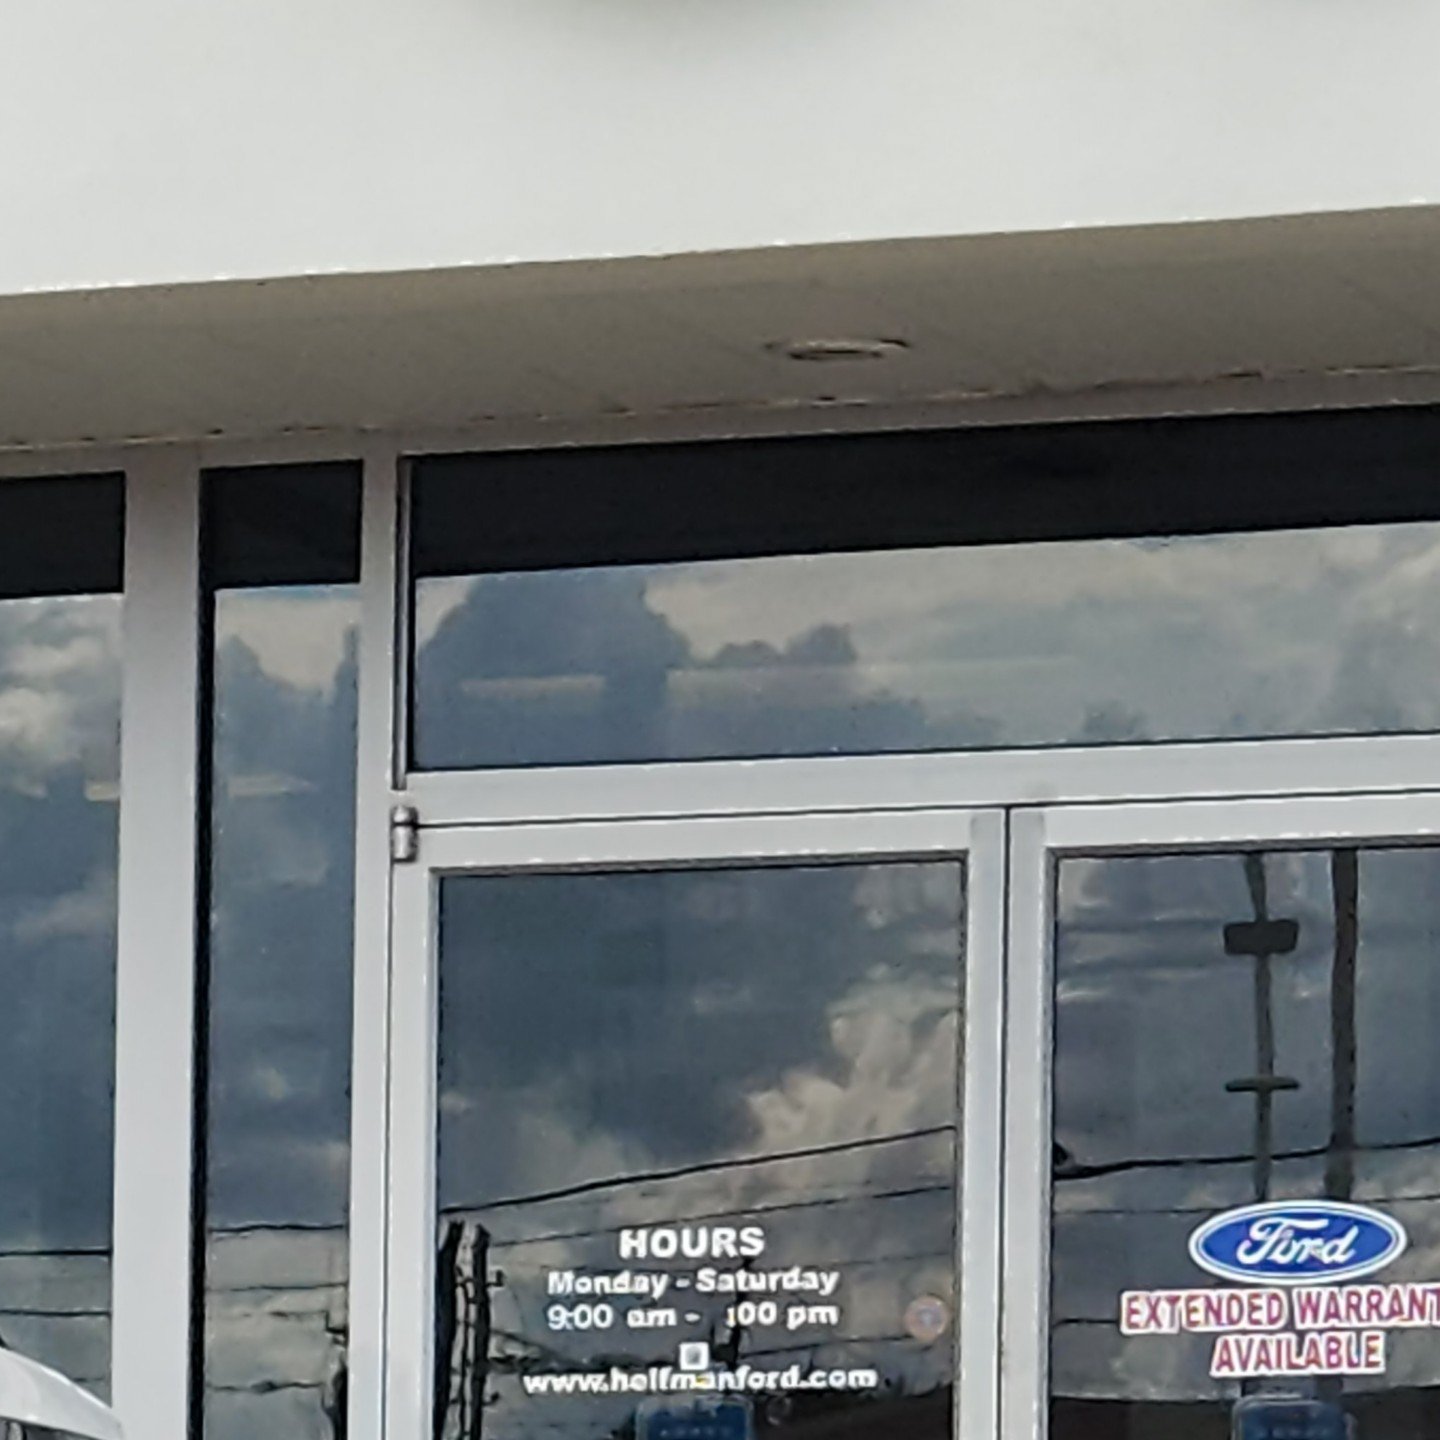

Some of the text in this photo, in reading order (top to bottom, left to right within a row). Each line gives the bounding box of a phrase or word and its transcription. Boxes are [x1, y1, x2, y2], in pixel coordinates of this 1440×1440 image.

[619, 1226, 765, 1258] HOURS
[547, 1269, 669, 1299] Monday
[696, 1266, 840, 1296] Saturday
[547, 1302, 614, 1331] 9:00
[627, 1307, 678, 1329] am
[787, 1304, 839, 1331] pm
[1123, 1289, 1286, 1332] EXTENDED
[1213, 1333, 1384, 1375] AVAILABLE
[522, 1365, 879, 1394] www.helfmanford.com
